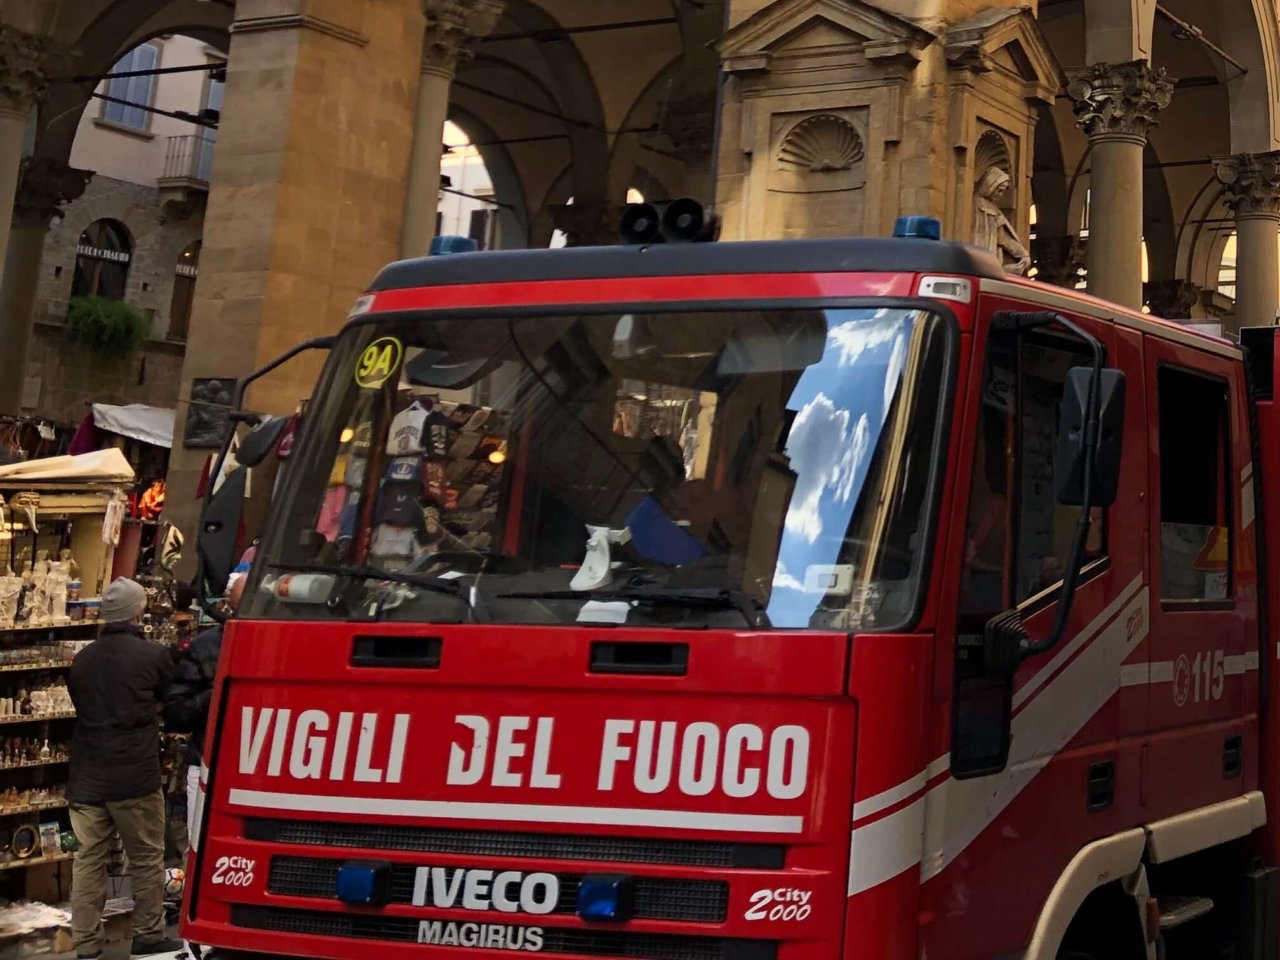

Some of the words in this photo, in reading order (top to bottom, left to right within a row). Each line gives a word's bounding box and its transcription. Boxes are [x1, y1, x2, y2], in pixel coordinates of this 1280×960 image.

[359, 343, 393, 377] 9A
[1191, 650, 1225, 702] 115
[238, 706, 411, 784] VIGILI
[447, 714, 562, 791] DEL
[597, 719, 811, 801] FUOCO
[229, 855, 256, 873] City
[411, 866, 560, 915] IVECO
[773, 887, 812, 906] City
[417, 920, 544, 952] MAGIRUS
